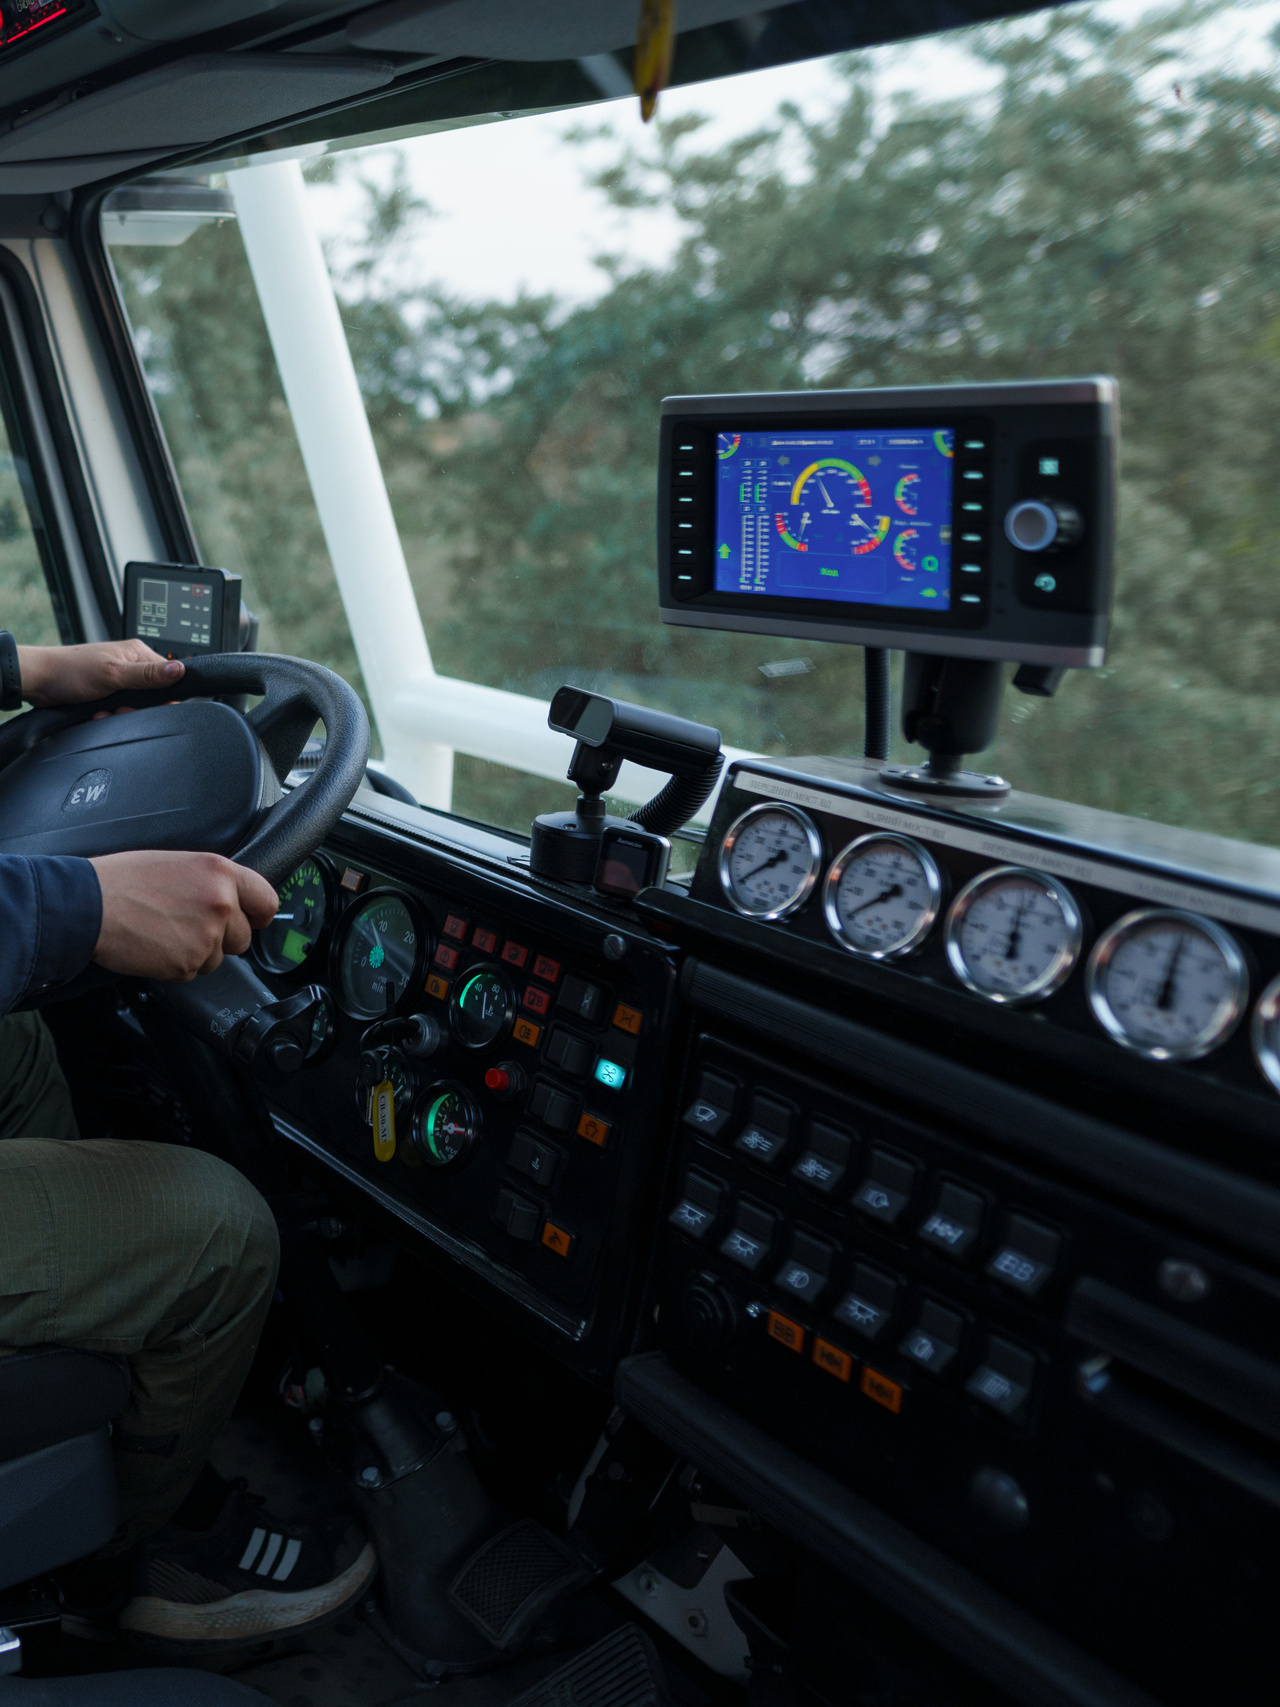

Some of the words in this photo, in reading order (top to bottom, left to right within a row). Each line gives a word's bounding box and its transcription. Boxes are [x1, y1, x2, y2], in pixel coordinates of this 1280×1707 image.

[378, 920, 388, 932] 10
[403, 931, 415, 945] 20
[360, 956, 367, 967] 0
[474, 983, 483, 992] 40
[491, 983, 500, 993] 80
